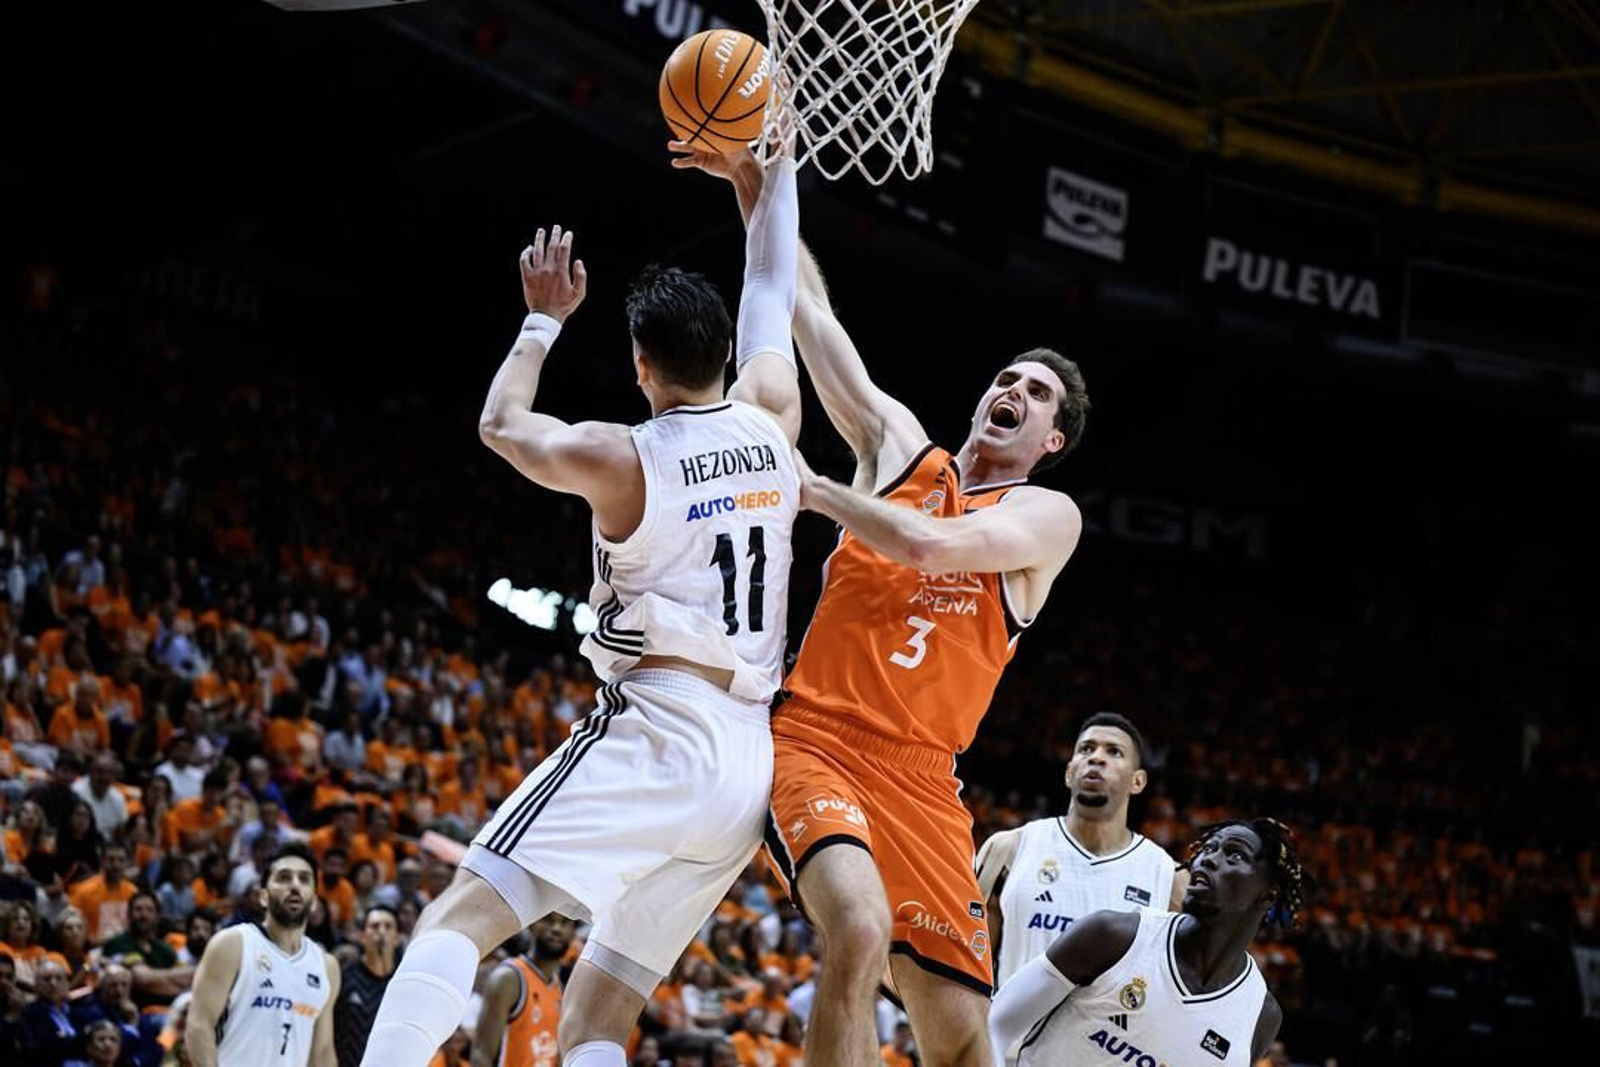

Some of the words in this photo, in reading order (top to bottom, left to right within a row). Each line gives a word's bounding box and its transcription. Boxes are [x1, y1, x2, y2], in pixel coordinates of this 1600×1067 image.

[1202, 236, 1381, 320] PULEVA
[680, 445, 777, 486] HEZONJA
[687, 490, 782, 522] AUTOHERO
[709, 526, 767, 636] 11
[888, 615, 937, 669] 3
[1028, 913, 1074, 932] AUT
[281, 1023, 292, 1055] 7
